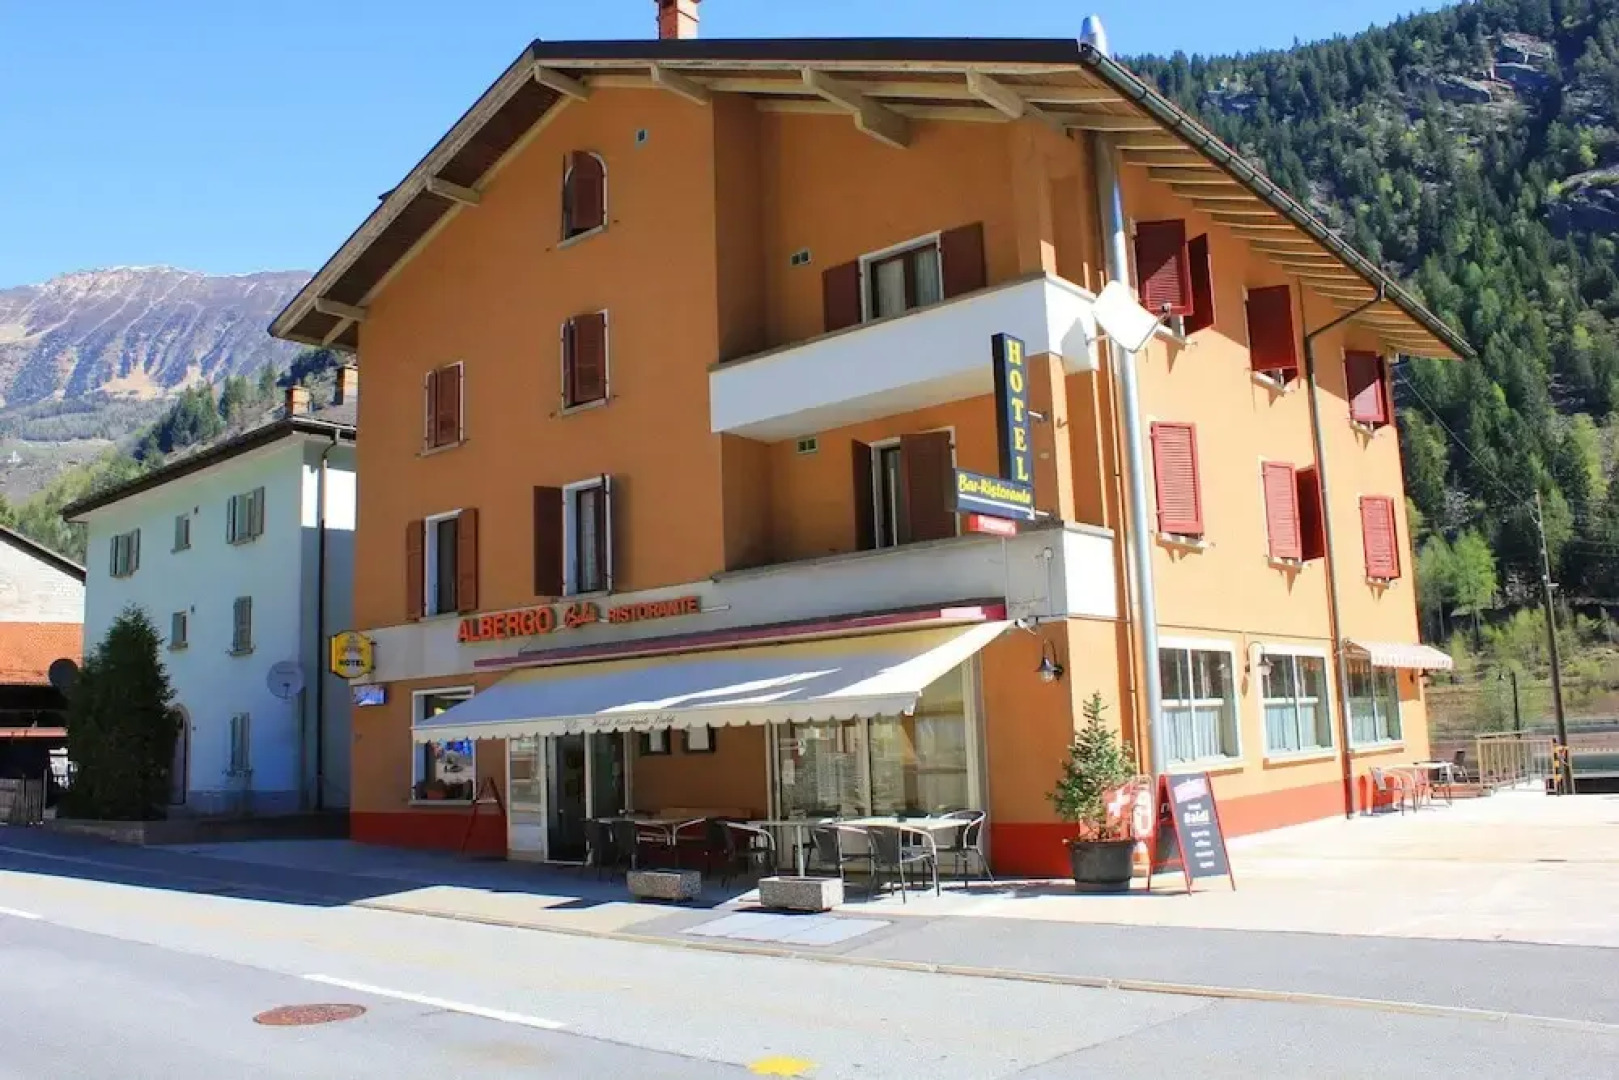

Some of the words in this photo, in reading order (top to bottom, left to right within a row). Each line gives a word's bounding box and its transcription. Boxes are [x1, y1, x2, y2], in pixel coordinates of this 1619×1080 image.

[1006, 339, 1029, 482] HOTEL
[958, 473, 1031, 504] Bar-Ristorante
[457, 606, 555, 643] ALBERGO
[608, 596, 701, 623] RISTORANTE
[339, 658, 366, 668] HOTEL
